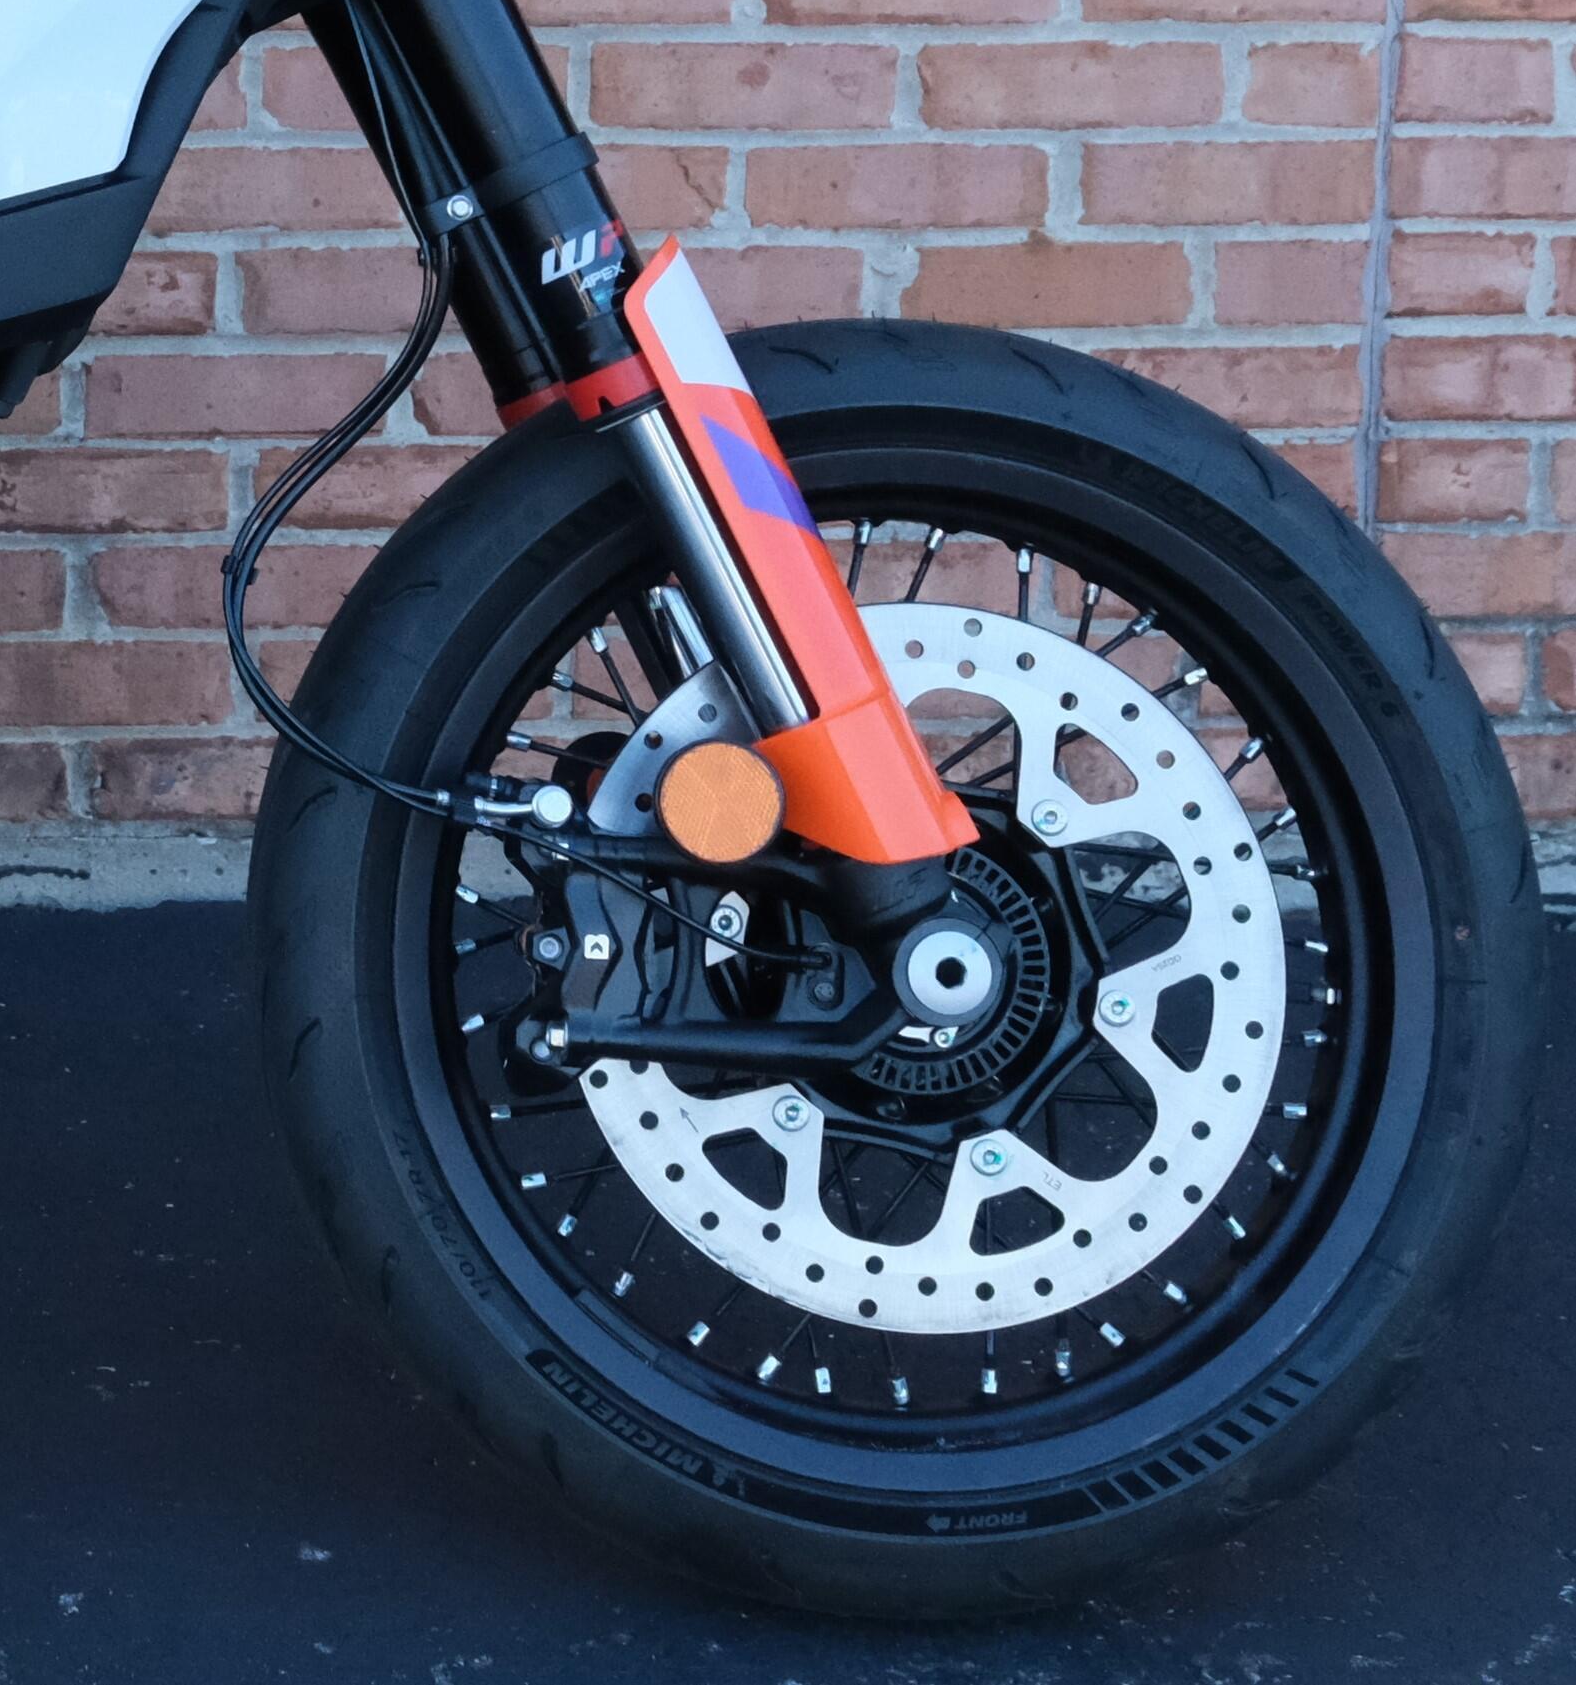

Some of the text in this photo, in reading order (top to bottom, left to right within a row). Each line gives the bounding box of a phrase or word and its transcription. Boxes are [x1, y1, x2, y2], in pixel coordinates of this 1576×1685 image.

[579, 260, 626, 292] APEX
[545, 1359, 702, 1478] MICHELIN
[952, 1509, 1028, 1530] FRONT
